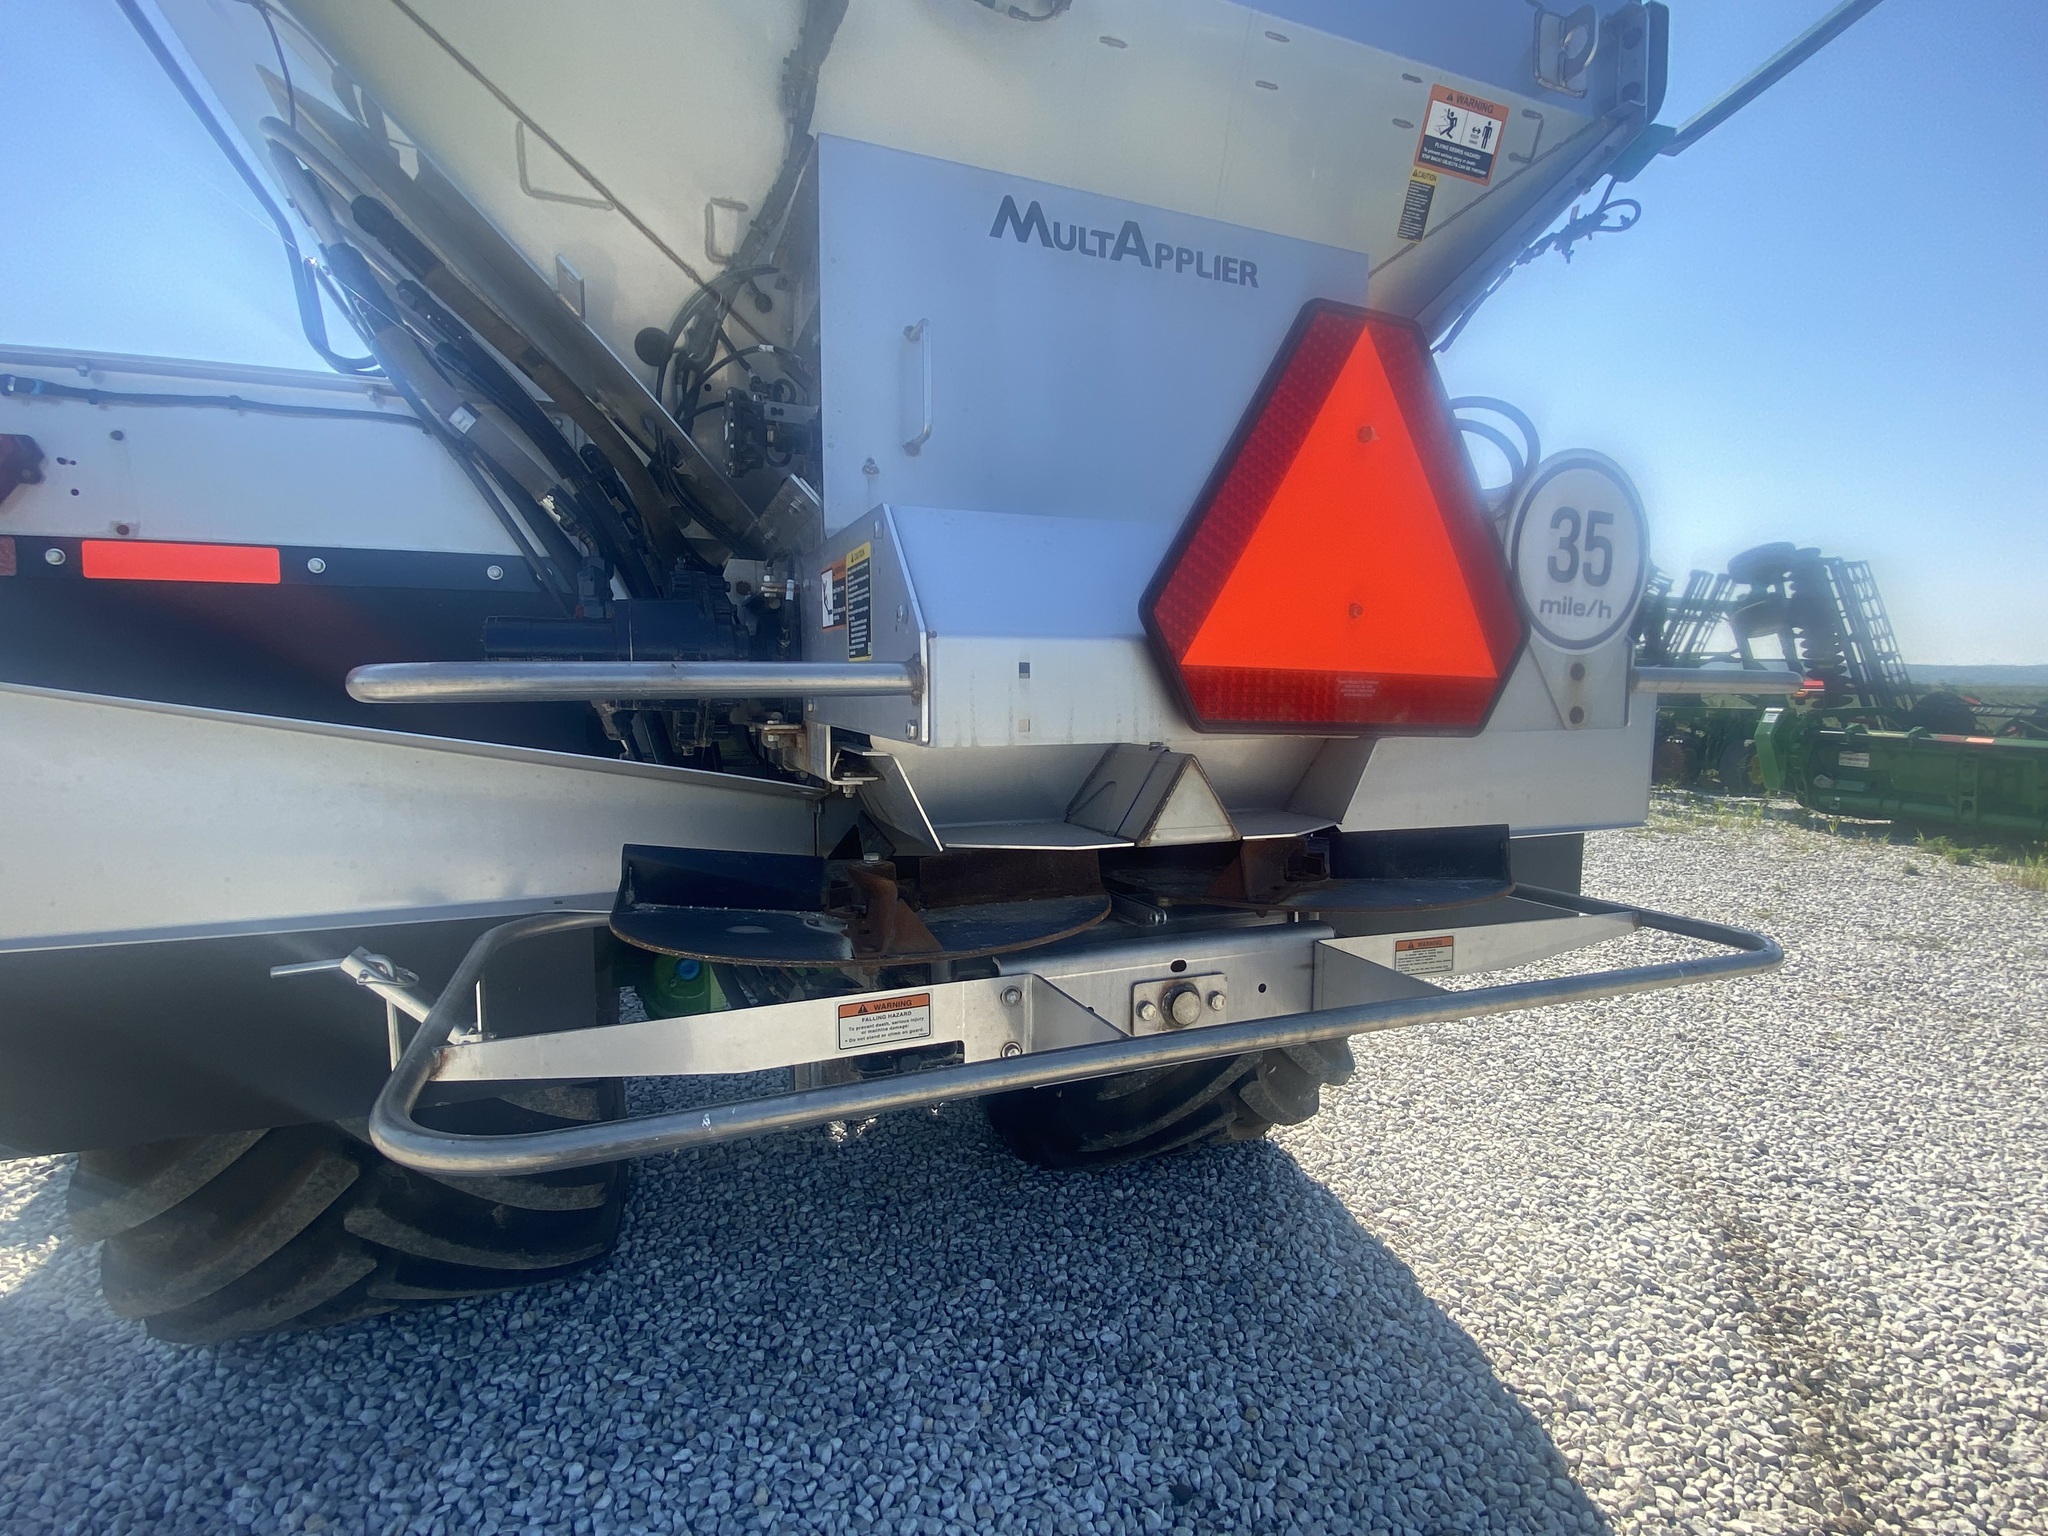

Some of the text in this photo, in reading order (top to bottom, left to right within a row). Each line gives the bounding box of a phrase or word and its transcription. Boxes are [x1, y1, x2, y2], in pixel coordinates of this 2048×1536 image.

[1456, 94, 1493, 114] WARNING
[1435, 142, 1449, 151] FLYING
[1418, 171, 1437, 181] CAUTION
[1547, 506, 1615, 587] 35
[1540, 596, 1612, 619] mile/h
[874, 1000, 912, 1011] WARNING
[888, 1011, 912, 1019] HAZARD
